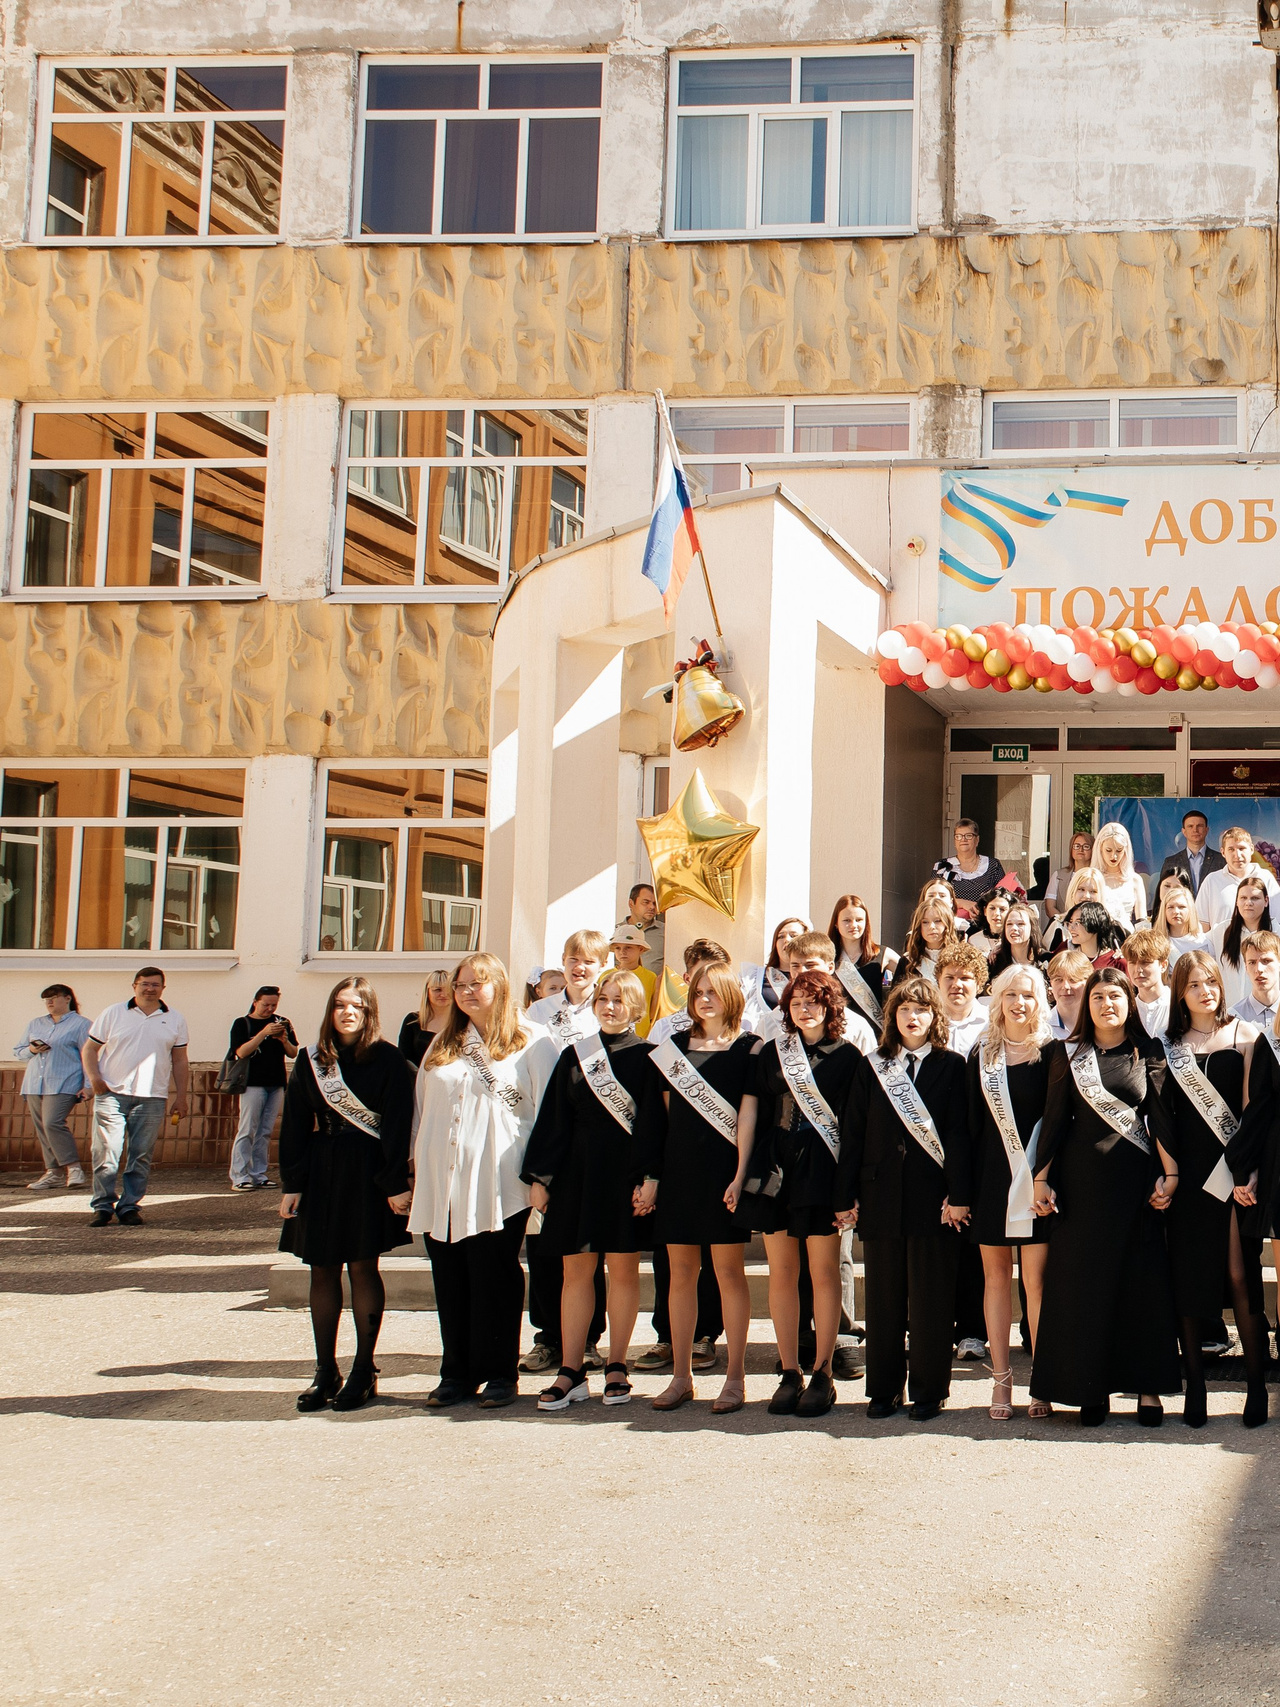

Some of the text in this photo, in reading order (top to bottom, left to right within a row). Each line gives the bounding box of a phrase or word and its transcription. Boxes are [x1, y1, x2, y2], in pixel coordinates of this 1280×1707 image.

[998, 748, 1024, 760] ВХОД
[497, 1084, 523, 1108] 2025
[678, 1075, 738, 1137] Выпускник
[784, 1055, 825, 1124] Выпускник
[1169, 1049, 1238, 1135] Выпускник 2025
[1005, 1128, 1022, 1151] 2025
